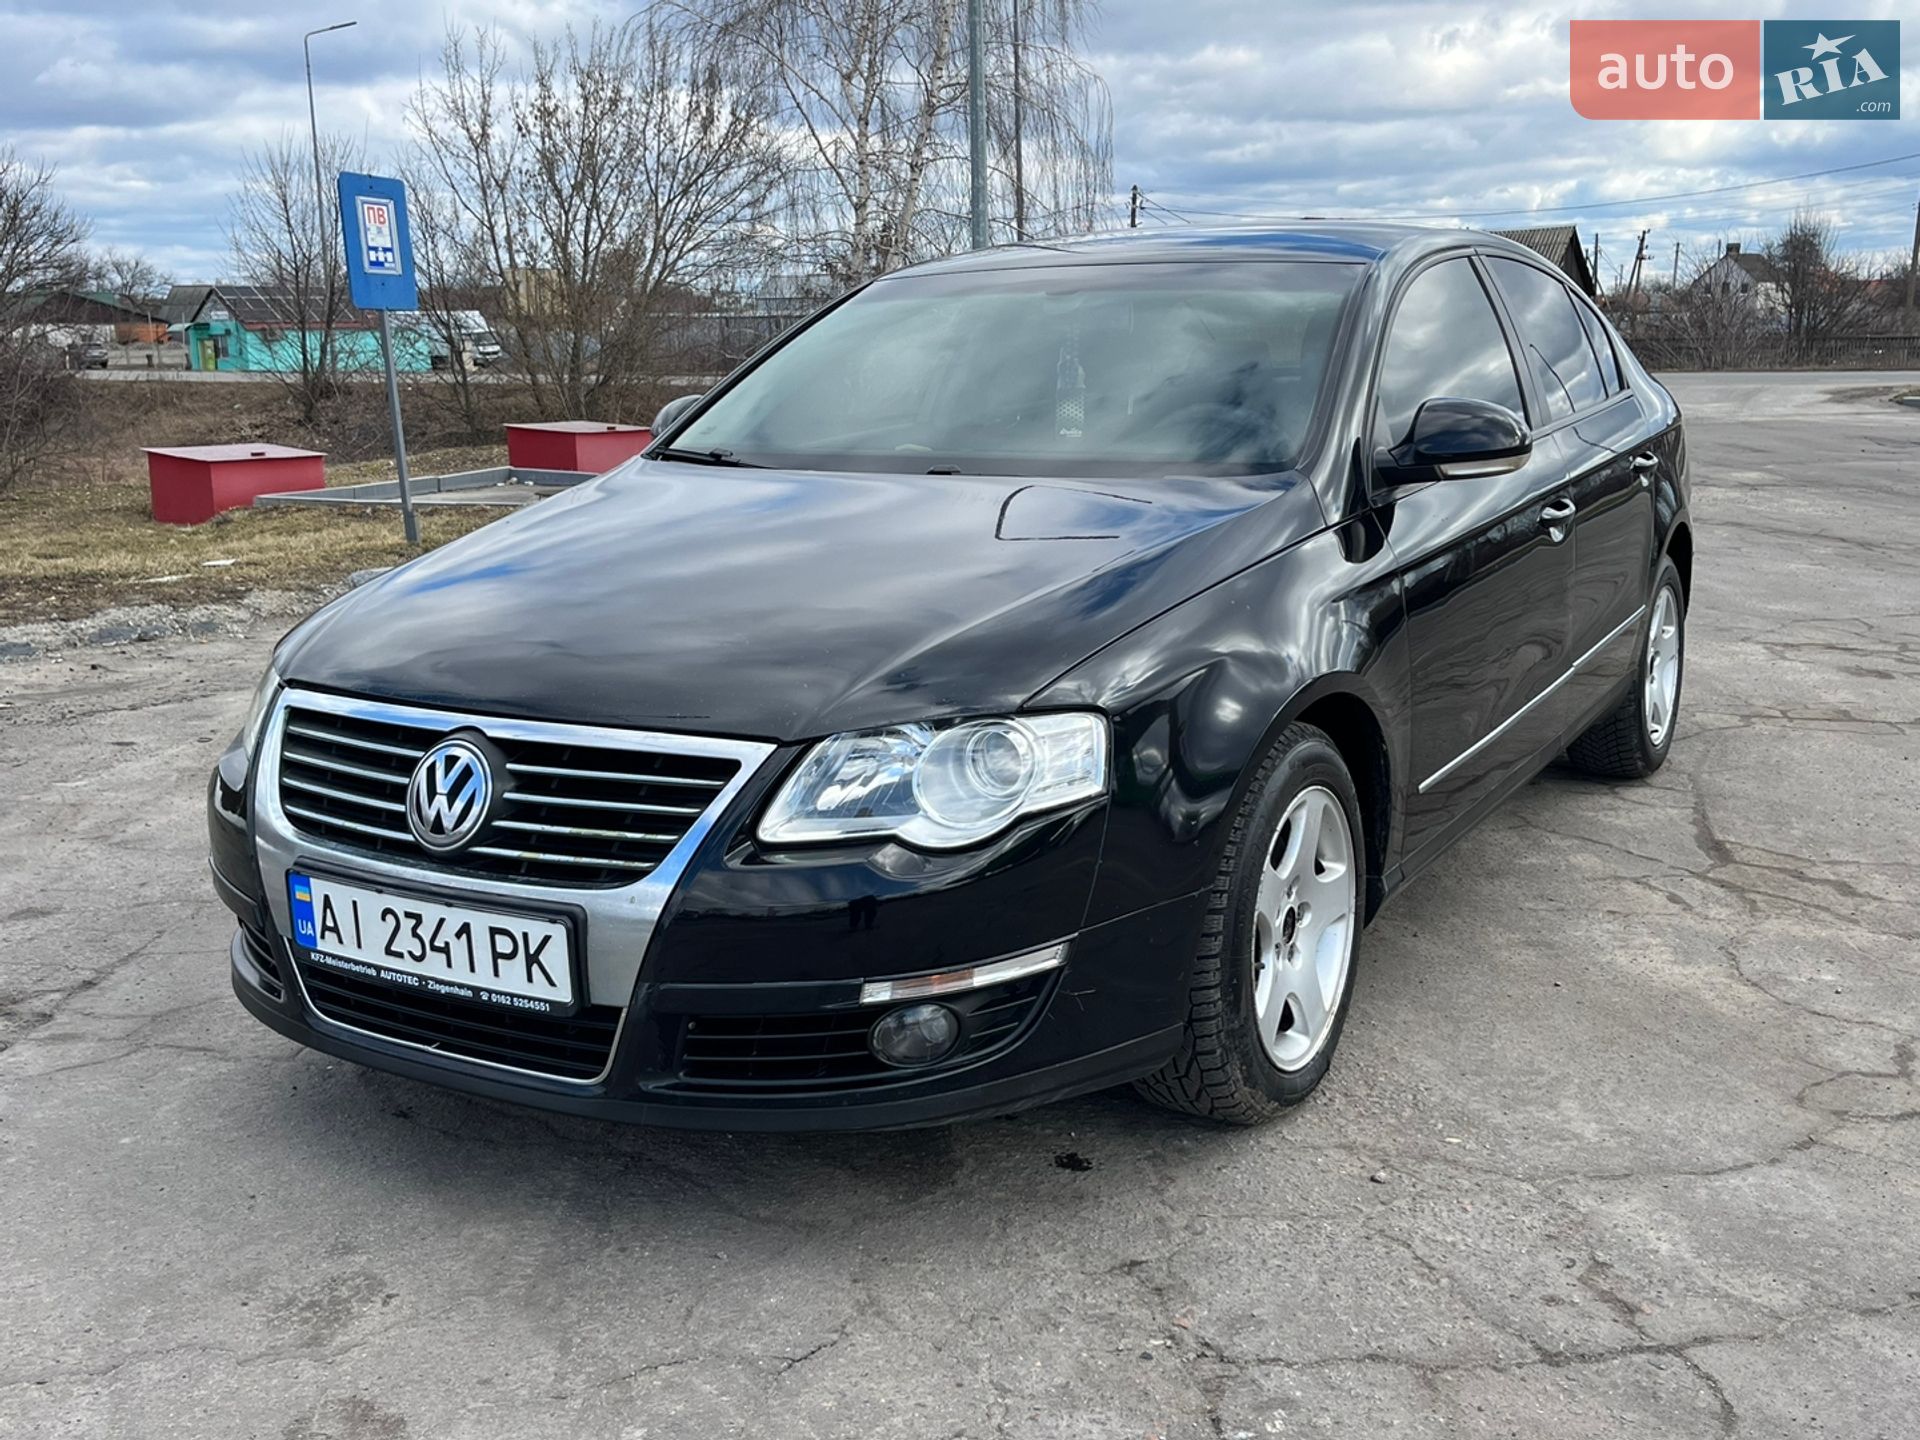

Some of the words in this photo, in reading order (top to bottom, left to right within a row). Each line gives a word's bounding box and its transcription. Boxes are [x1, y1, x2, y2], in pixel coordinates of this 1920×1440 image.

[366, 206, 386, 225] ПВ
[298, 920, 314, 936] UA
[381, 907, 475, 973] 2341
[489, 926, 557, 988] PK
[379, 969, 419, 986] AUTOTEC
